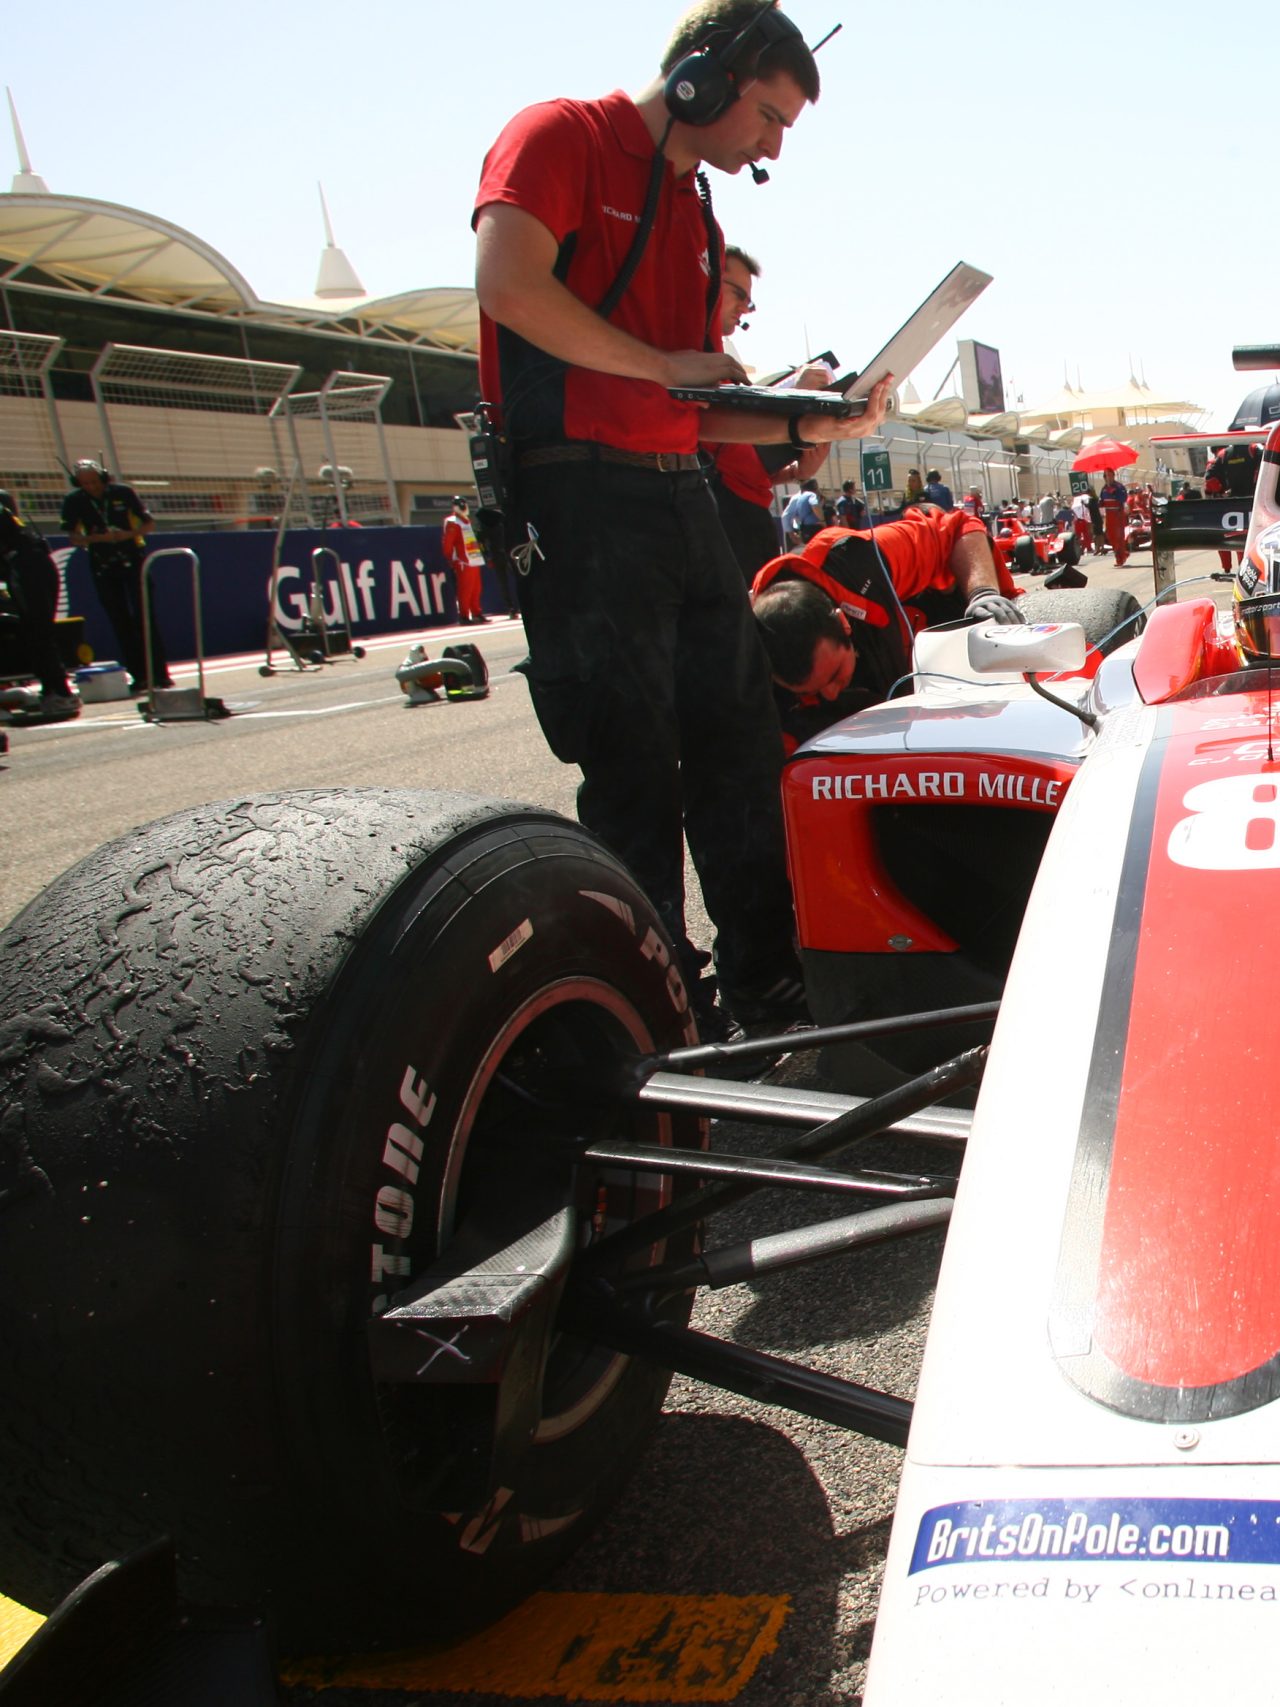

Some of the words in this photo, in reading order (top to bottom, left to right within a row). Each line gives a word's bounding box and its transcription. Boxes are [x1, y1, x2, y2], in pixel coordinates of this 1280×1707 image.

[867, 468, 884, 485] 11
[1072, 481, 1088, 493] 20
[268, 560, 375, 630] Gulf
[390, 558, 446, 620] Air
[812, 772, 965, 800] RICHARD
[979, 773, 1062, 806] MILLE
[926, 1512, 1230, 1563] BritsOnPole.com
[914, 1578, 1050, 1607] Powered
[1064, 1578, 1101, 1603] by
